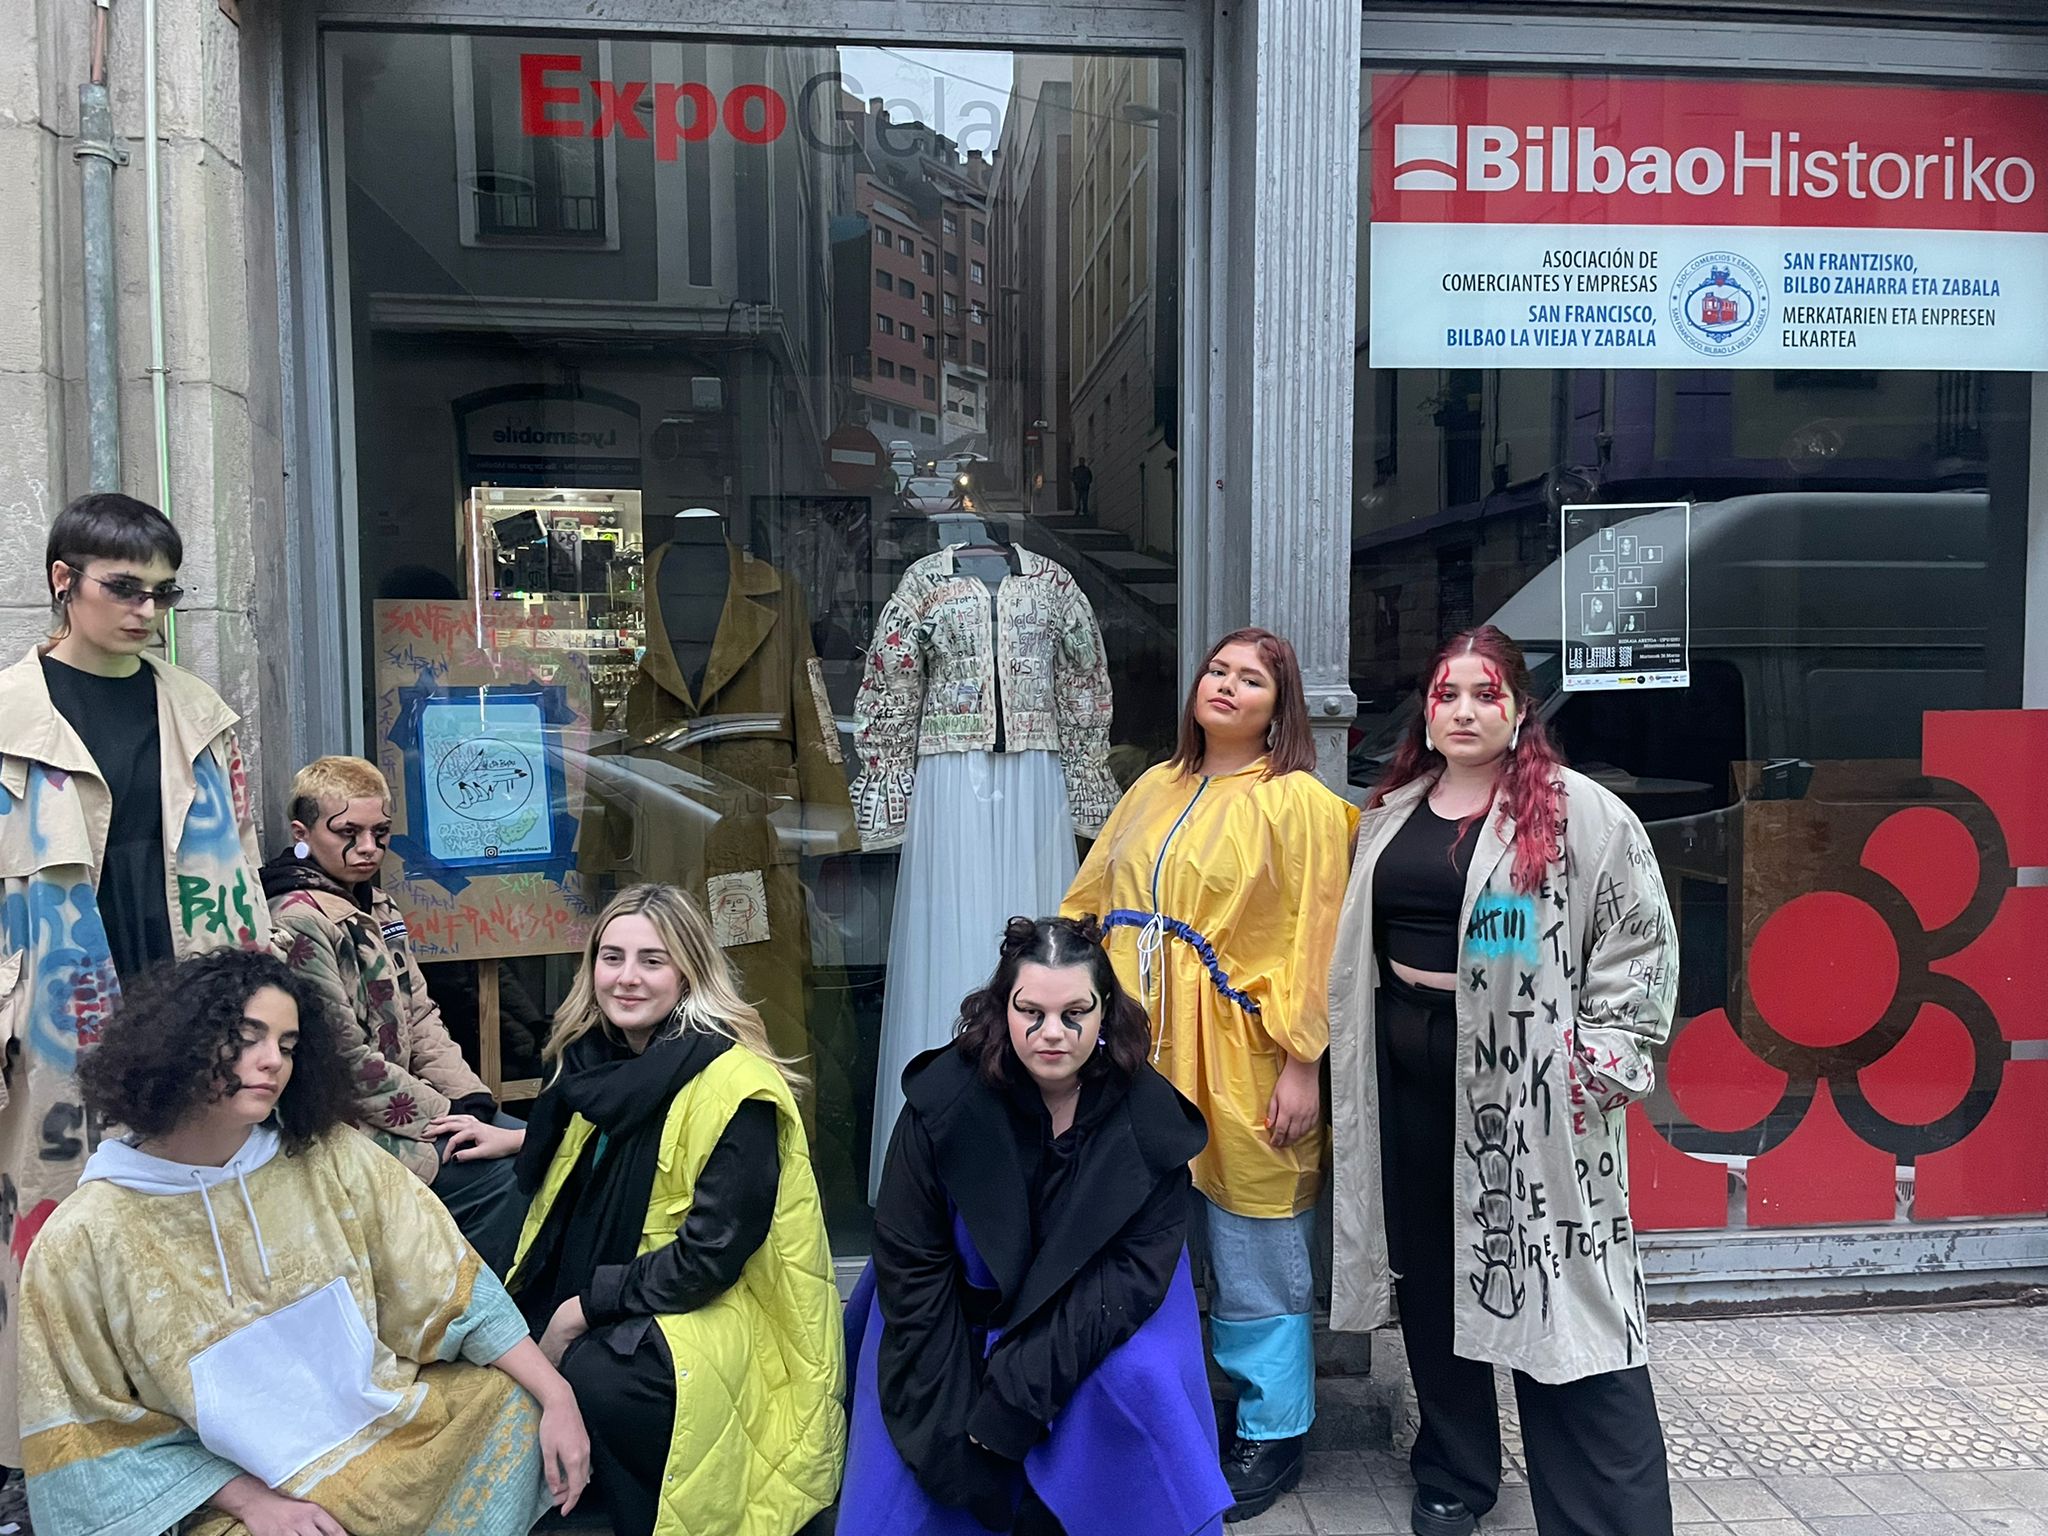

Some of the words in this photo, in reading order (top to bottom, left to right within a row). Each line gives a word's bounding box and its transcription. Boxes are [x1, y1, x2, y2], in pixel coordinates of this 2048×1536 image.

[1542, 247, 1634, 269] ASOCIACIÓN
[1639, 251, 1658, 269] DE
[1784, 252, 1815, 271] SAN
[1819, 253, 1918, 274] FRANTZISKO,
[1691, 254, 1732, 271] COMERCIOS
[1736, 258, 1764, 290] EMPRESAS
[1442, 273, 1560, 292] COMERCIANTES
[1563, 274, 1573, 292] Y
[1577, 274, 1658, 293] EMPRESAS
[1783, 276, 1831, 294] BILBO
[1834, 277, 1907, 295] ZAHARRA
[1912, 278, 1938, 296] ETA
[1942, 278, 2000, 297] ZABALA
[1529, 304, 1560, 323] SAN
[1565, 305, 1657, 326] FRANCISCO,
[1782, 306, 1887, 325] MERKATARIEN
[1892, 307, 1917, 325] ETA
[1921, 308, 1996, 326] ENPRESEN
[1447, 328, 1506, 347] BILBAO
[1510, 328, 1530, 347] LA
[1534, 328, 1578, 347] VIEJA
[1581, 329, 1591, 347] Y
[1594, 329, 1657, 347] ZABALA
[1782, 330, 1857, 348] ELKARTEA
